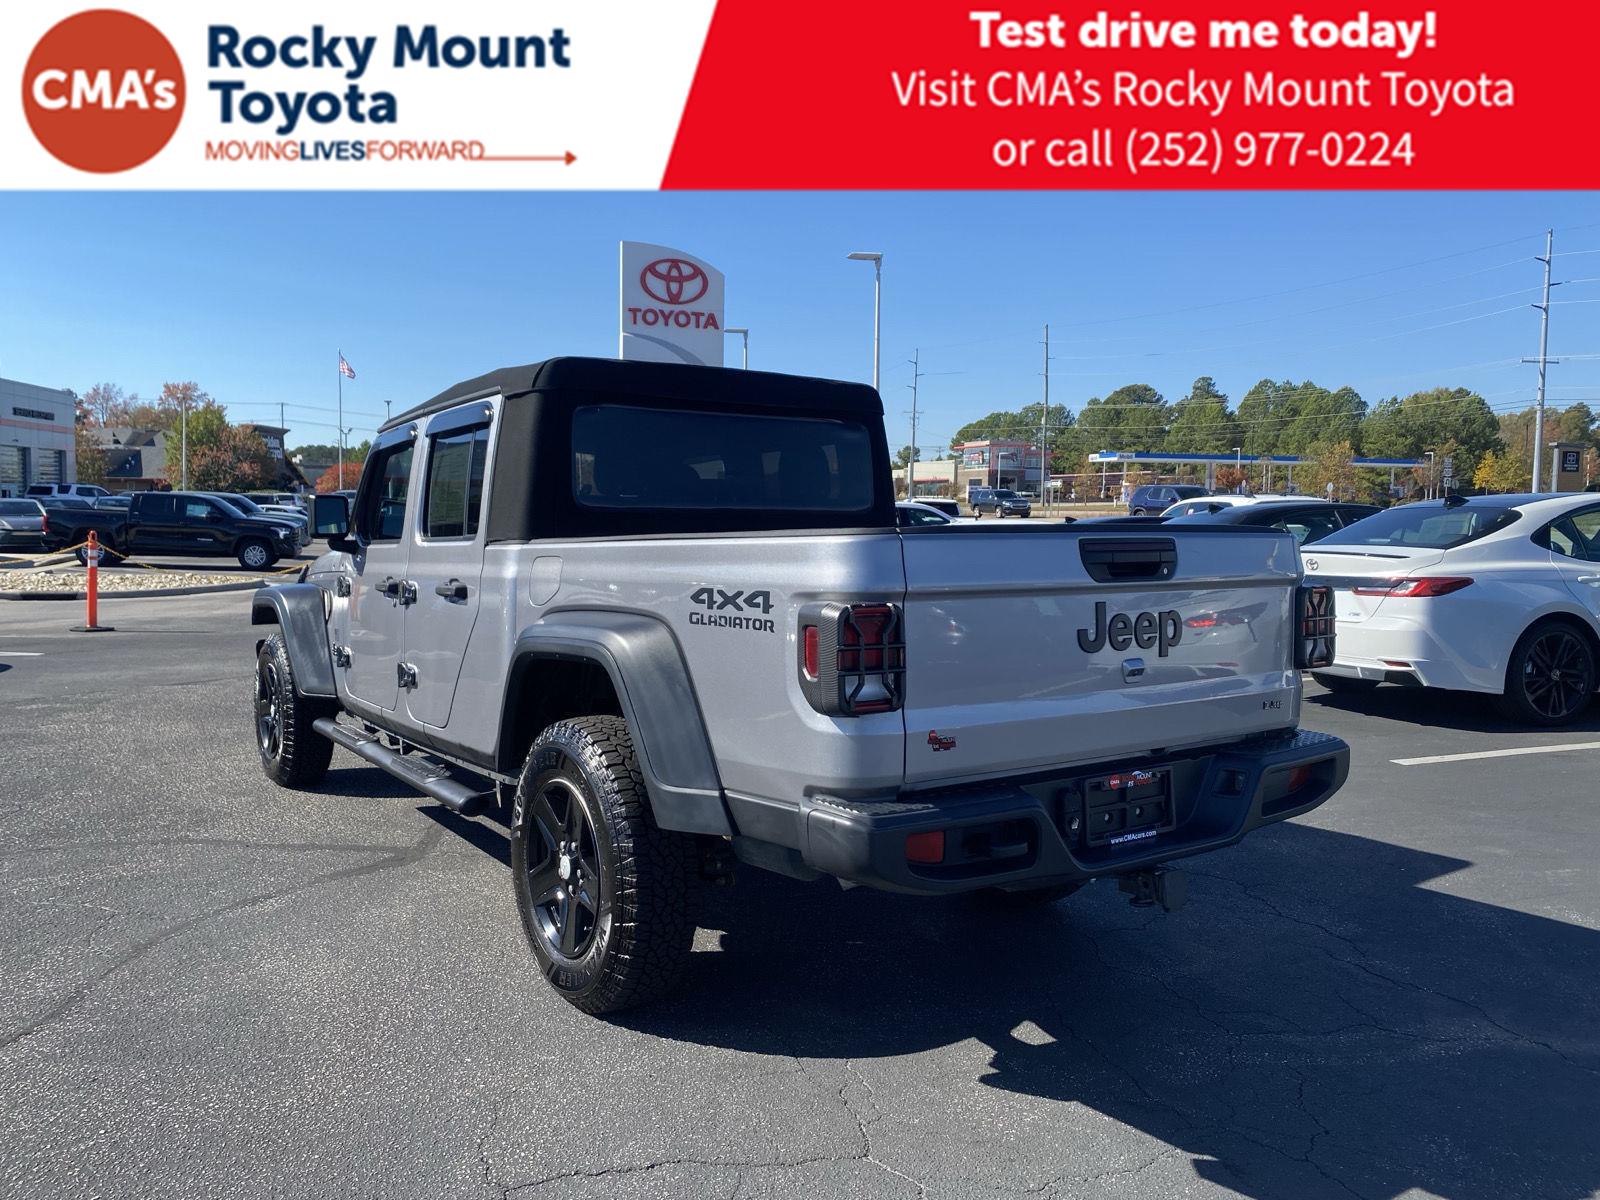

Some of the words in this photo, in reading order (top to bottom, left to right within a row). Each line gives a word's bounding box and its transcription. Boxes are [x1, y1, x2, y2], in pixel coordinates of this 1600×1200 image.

[627, 307, 719, 330] TOYOTA
[689, 612, 775, 633] GLADIATOR
[1077, 601, 1183, 657] Jeep
